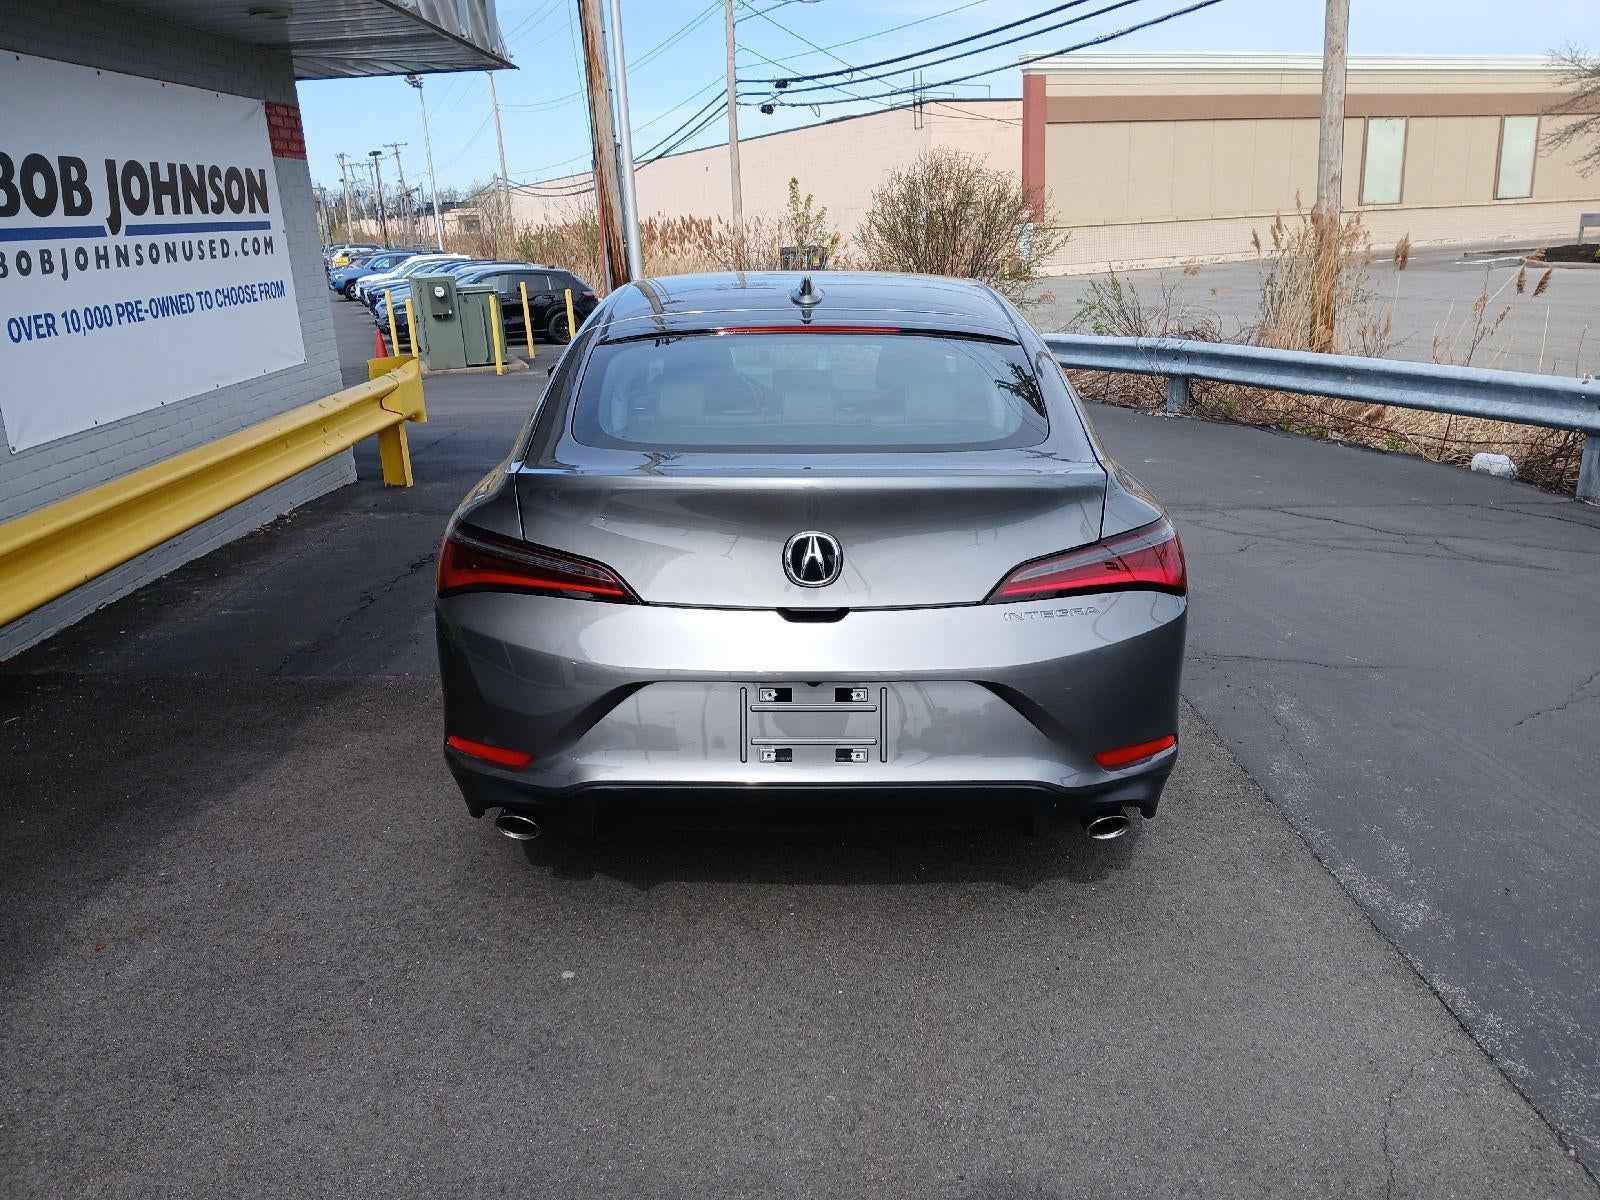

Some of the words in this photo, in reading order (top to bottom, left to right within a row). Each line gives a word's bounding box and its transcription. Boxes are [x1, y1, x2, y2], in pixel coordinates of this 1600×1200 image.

[0, 151, 93, 218] BOB
[104, 158, 270, 236] JOHNSON
[0, 235, 275, 282] BOBJOHNSONUSED.COM
[7, 312, 59, 344] OVER
[61, 304, 114, 337] 10,000
[114, 293, 195, 326] PRE-OWNED
[196, 290, 214, 312] TO
[215, 284, 259, 308] CHOOSE
[257, 280, 286, 301] FROM
[1003, 606, 1101, 621] INTEGRA
